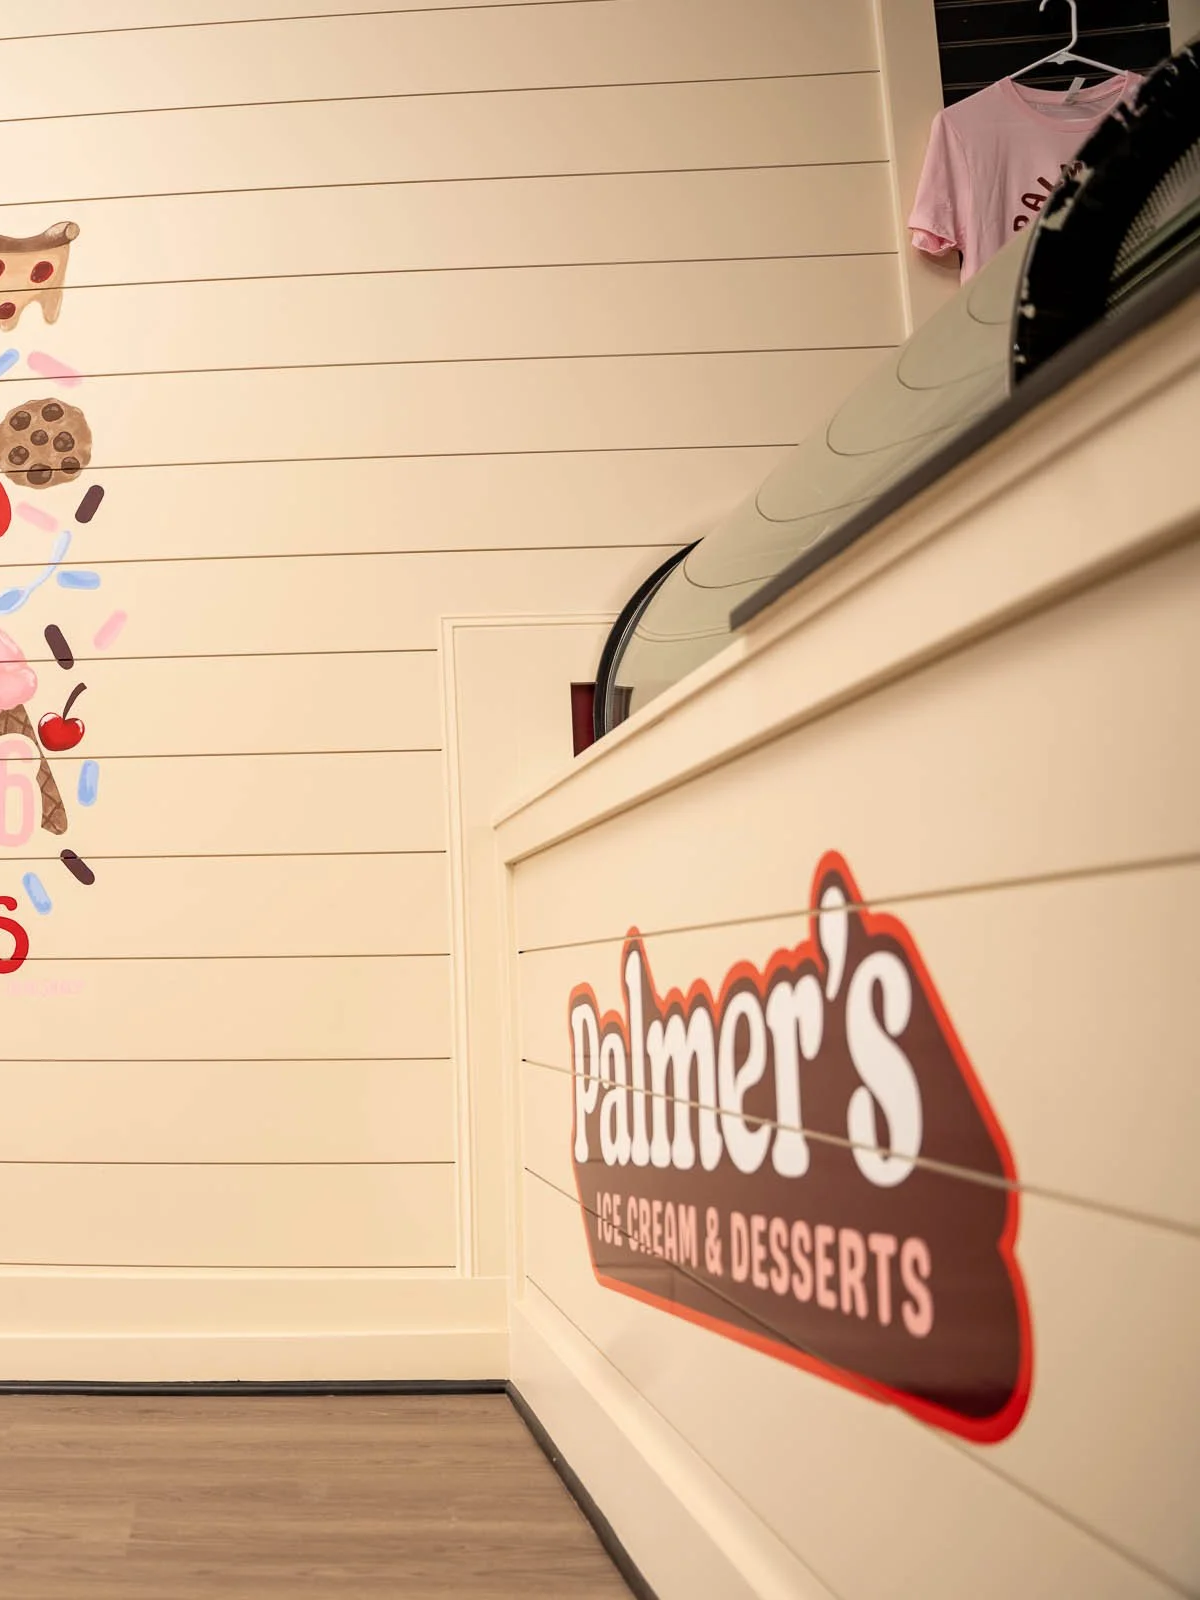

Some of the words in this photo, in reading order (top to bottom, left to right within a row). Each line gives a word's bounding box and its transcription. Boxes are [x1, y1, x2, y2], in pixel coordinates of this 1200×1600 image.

[571, 886, 923, 1187] Palmer's
[596, 1191, 622, 1247] ICE
[626, 1195, 699, 1269] CREAM
[704, 1206, 724, 1277] &
[729, 1210, 934, 1339] DESSERTS
